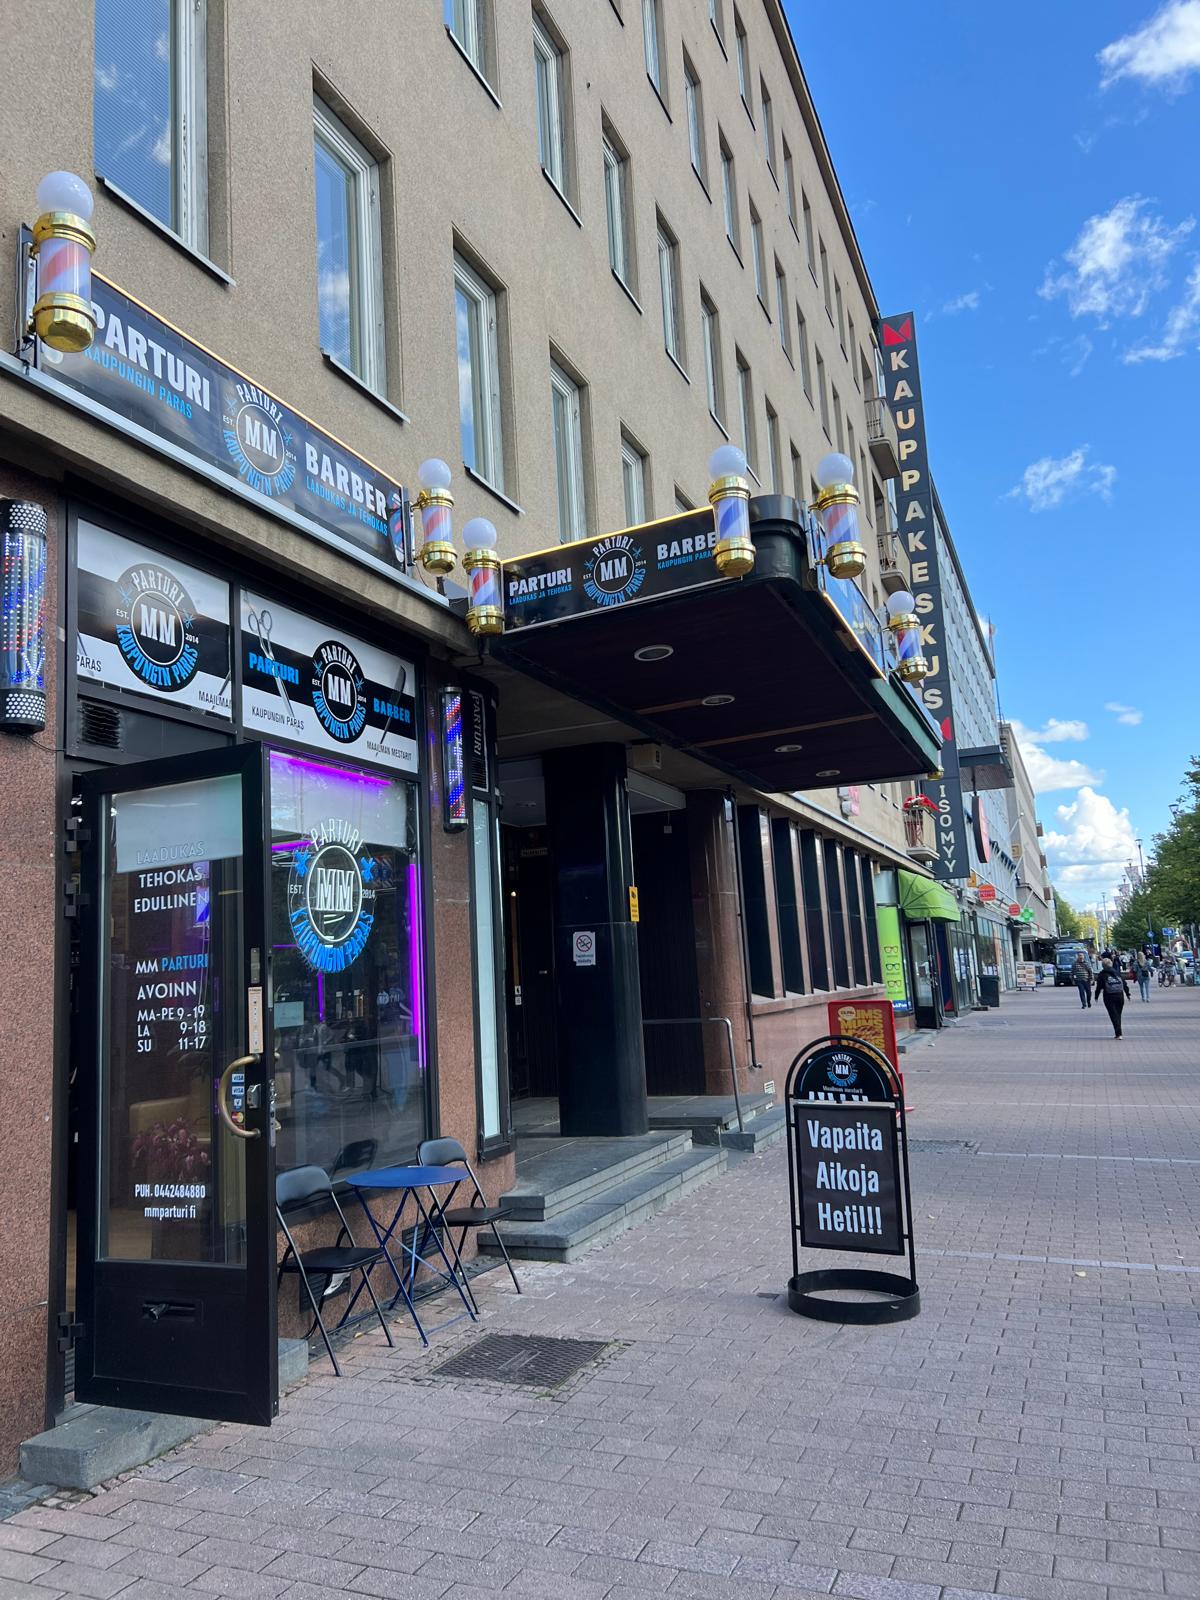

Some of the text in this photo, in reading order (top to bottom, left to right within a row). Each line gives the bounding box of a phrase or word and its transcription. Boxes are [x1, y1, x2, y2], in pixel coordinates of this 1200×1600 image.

[84, 346, 193, 420] KAUPUNGIN PARAS
[236, 384, 283, 423] PARTURI
[223, 415, 235, 427] EST.
[245, 414, 277, 460] MM
[223, 429, 296, 496] KAUPUNGIN PARAS
[285, 449, 297, 461] 2014
[305, 442, 388, 520] BARBER
[306, 475, 388, 537] LAADUKAS JA TEHOKAS
[592, 536, 634, 557] PARTURI
[657, 532, 717, 560] BARBE
[657, 549, 714, 569] KAUPUNGIN PARA
[509, 567, 572, 597] PARTURI
[600, 556, 628, 582] MM
[131, 569, 185, 607] PARTURI
[509, 584, 572, 606] LAADUKAS JA TEHOKAS
[583, 568, 646, 606] KAUPUNGIN PARAS
[116, 608, 129, 619] EST.
[140, 604, 176, 647] MM
[185, 633, 199, 644] 2014
[115, 624, 199, 687] KAUPUNGIN PARAS
[248, 652, 299, 685] PARTURI
[321, 645, 357, 674] PARTURI
[312, 679, 321, 687] EST.
[327, 673, 352, 706] MM
[252, 706, 305, 730] KAUPUNGIN PARAS
[312, 690, 367, 739] KAUPUNGIN PARAS
[373, 698, 411, 724] BARBER
[472, 695, 482, 756] PARTURI
[311, 818, 364, 855] PARTURI
[939, 785, 958, 873] ISOMYY
[136, 841, 207, 865] LAADUKAS
[139, 867, 203, 889] TEHOKAS
[316, 868, 355, 912] MM
[134, 891, 208, 913] EDULLINEN
[291, 907, 374, 973] KAUPUNGIN PARAS
[135, 953, 208, 975] MM PARTURI
[137, 981, 197, 1001] AVOINN
[137, 1007, 174, 1022] MA-PE
[137, 1021, 206, 1038] LA 9-18
[137, 1037, 207, 1053] SU 11-17
[836, 1064, 849, 1075] MM
[807, 1120, 883, 1153] Vapaita
[135, 1184, 206, 1198] PUH. 0442484880
[816, 1161, 880, 1197] Aikoja
[817, 1202, 882, 1235] Heti!!!
